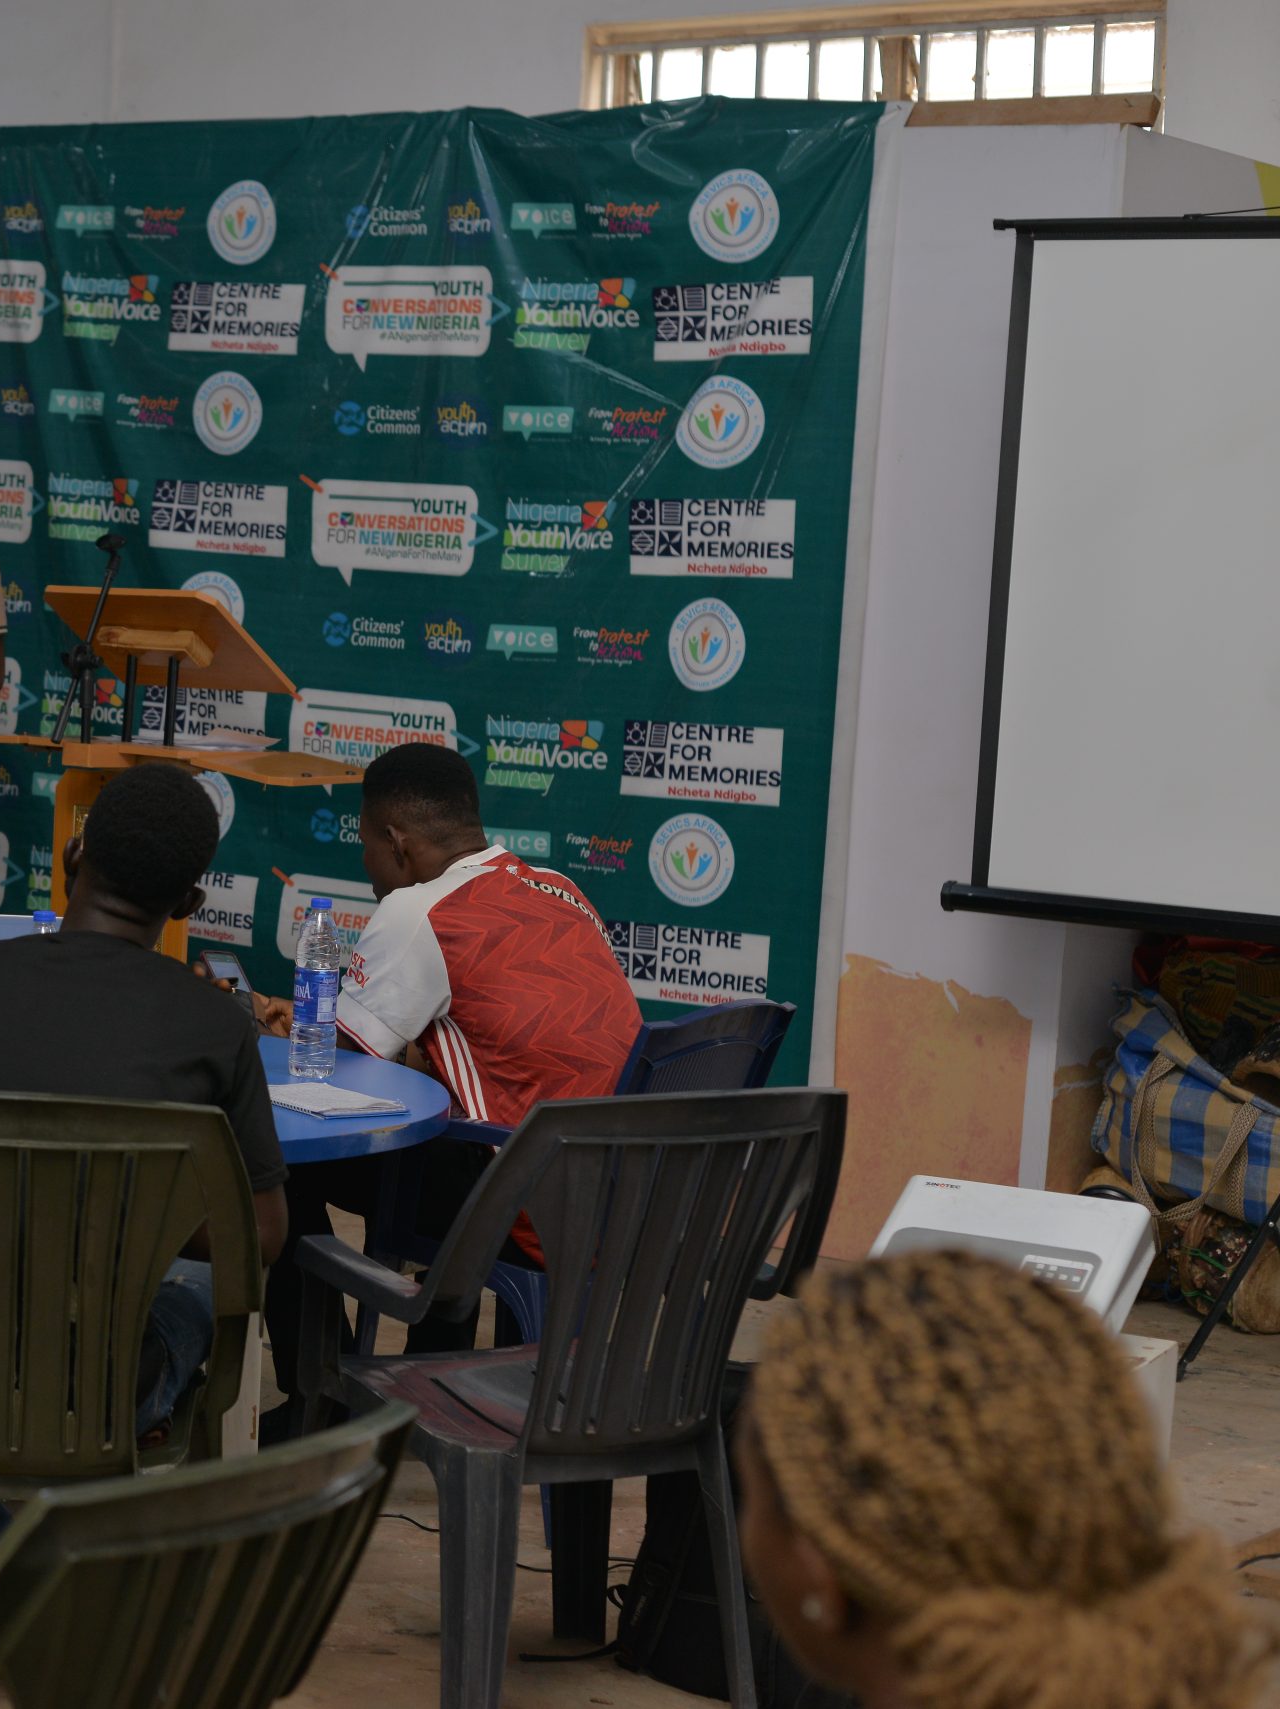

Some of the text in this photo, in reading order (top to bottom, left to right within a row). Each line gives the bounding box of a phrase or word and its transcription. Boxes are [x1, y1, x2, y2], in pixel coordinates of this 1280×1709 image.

[217, 284, 280, 299] CENTRE
[433, 281, 483, 296] YOUTH
[521, 276, 599, 308] Nigeria
[216, 302, 247, 317] FOR
[213, 321, 300, 337] MEMORIES
[740, 342, 785, 355] Ndigbo
[367, 405, 420, 421] Citizens'
[366, 421, 420, 435] Common
[203, 483, 265, 501] CENTRE
[201, 502, 232, 517] FOR
[412, 499, 466, 515] YOUTH
[507, 497, 582, 528] Nigeria
[688, 500, 766, 517] CENTRE
[199, 521, 286, 540] MEMORIES
[687, 521, 730, 537] FOR
[687, 541, 793, 559] MEMORIES
[688, 563, 767, 576] Ncheta Ndigbo
[352, 617, 404, 635] Citizens'
[351, 632, 405, 649] Common
[598, 626, 650, 645] Protest
[589, 641, 598, 651] to
[189, 704, 216, 719] FOR
[391, 713, 445, 731] YOUTH
[487, 714, 560, 744] Nigeria
[671, 723, 754, 744] CENTRE
[489, 739, 608, 770] YouthVoice
[669, 744, 712, 762] FOR
[486, 762, 554, 796] Survey
[668, 765, 781, 787] MEMORIES
[668, 786, 756, 803] Ncheta Ndigbo
[656, 818, 726, 849] SEVICS AFRICA
[589, 835, 633, 853] Protest
[662, 927, 742, 949] CENTRE
[661, 948, 701, 965] FOR
[661, 969, 766, 993] MEMORIES
[659, 988, 699, 1002] Ncheta
